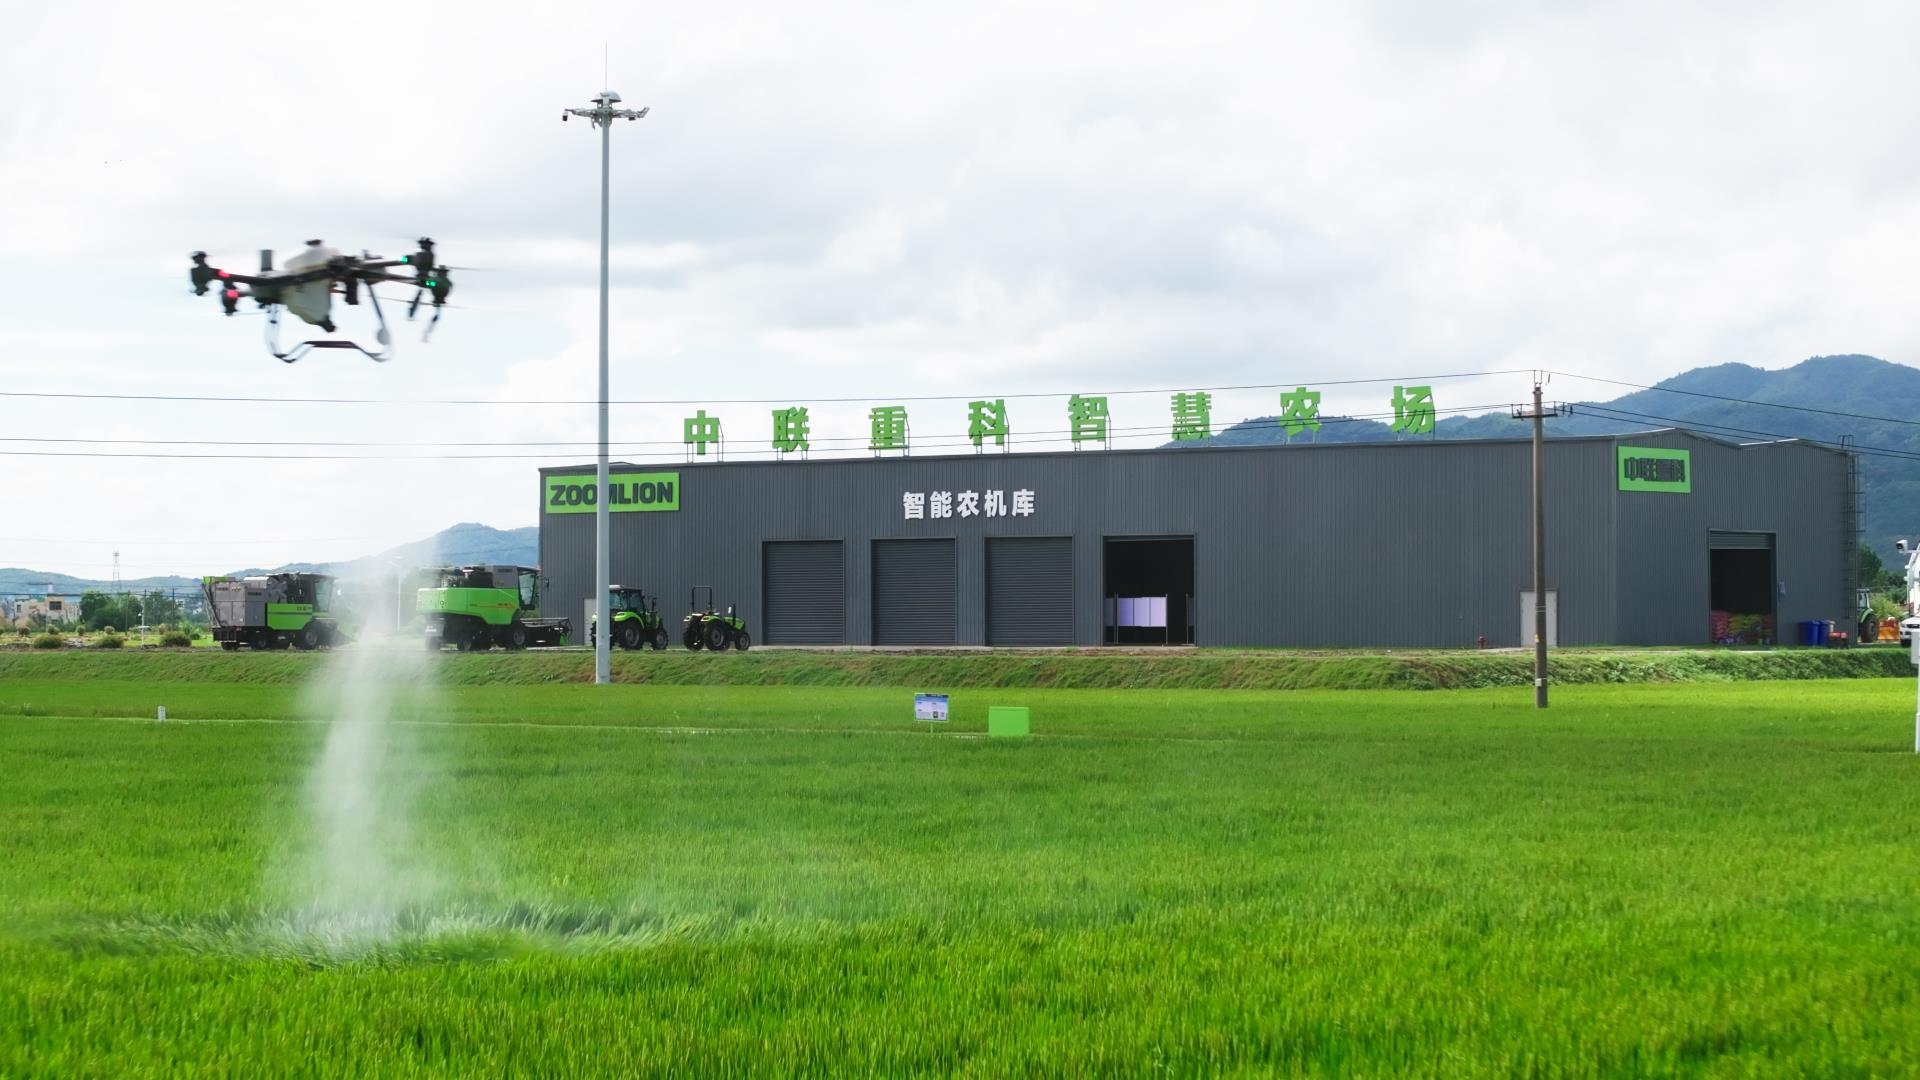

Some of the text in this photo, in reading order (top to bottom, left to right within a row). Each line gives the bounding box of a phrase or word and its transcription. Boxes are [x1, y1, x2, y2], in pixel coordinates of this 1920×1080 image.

[684, 386, 1435, 455] 中联重科智慧农场
[1624, 457, 1685, 482] 中联
[903, 489, 1035, 520] 智能农机库
